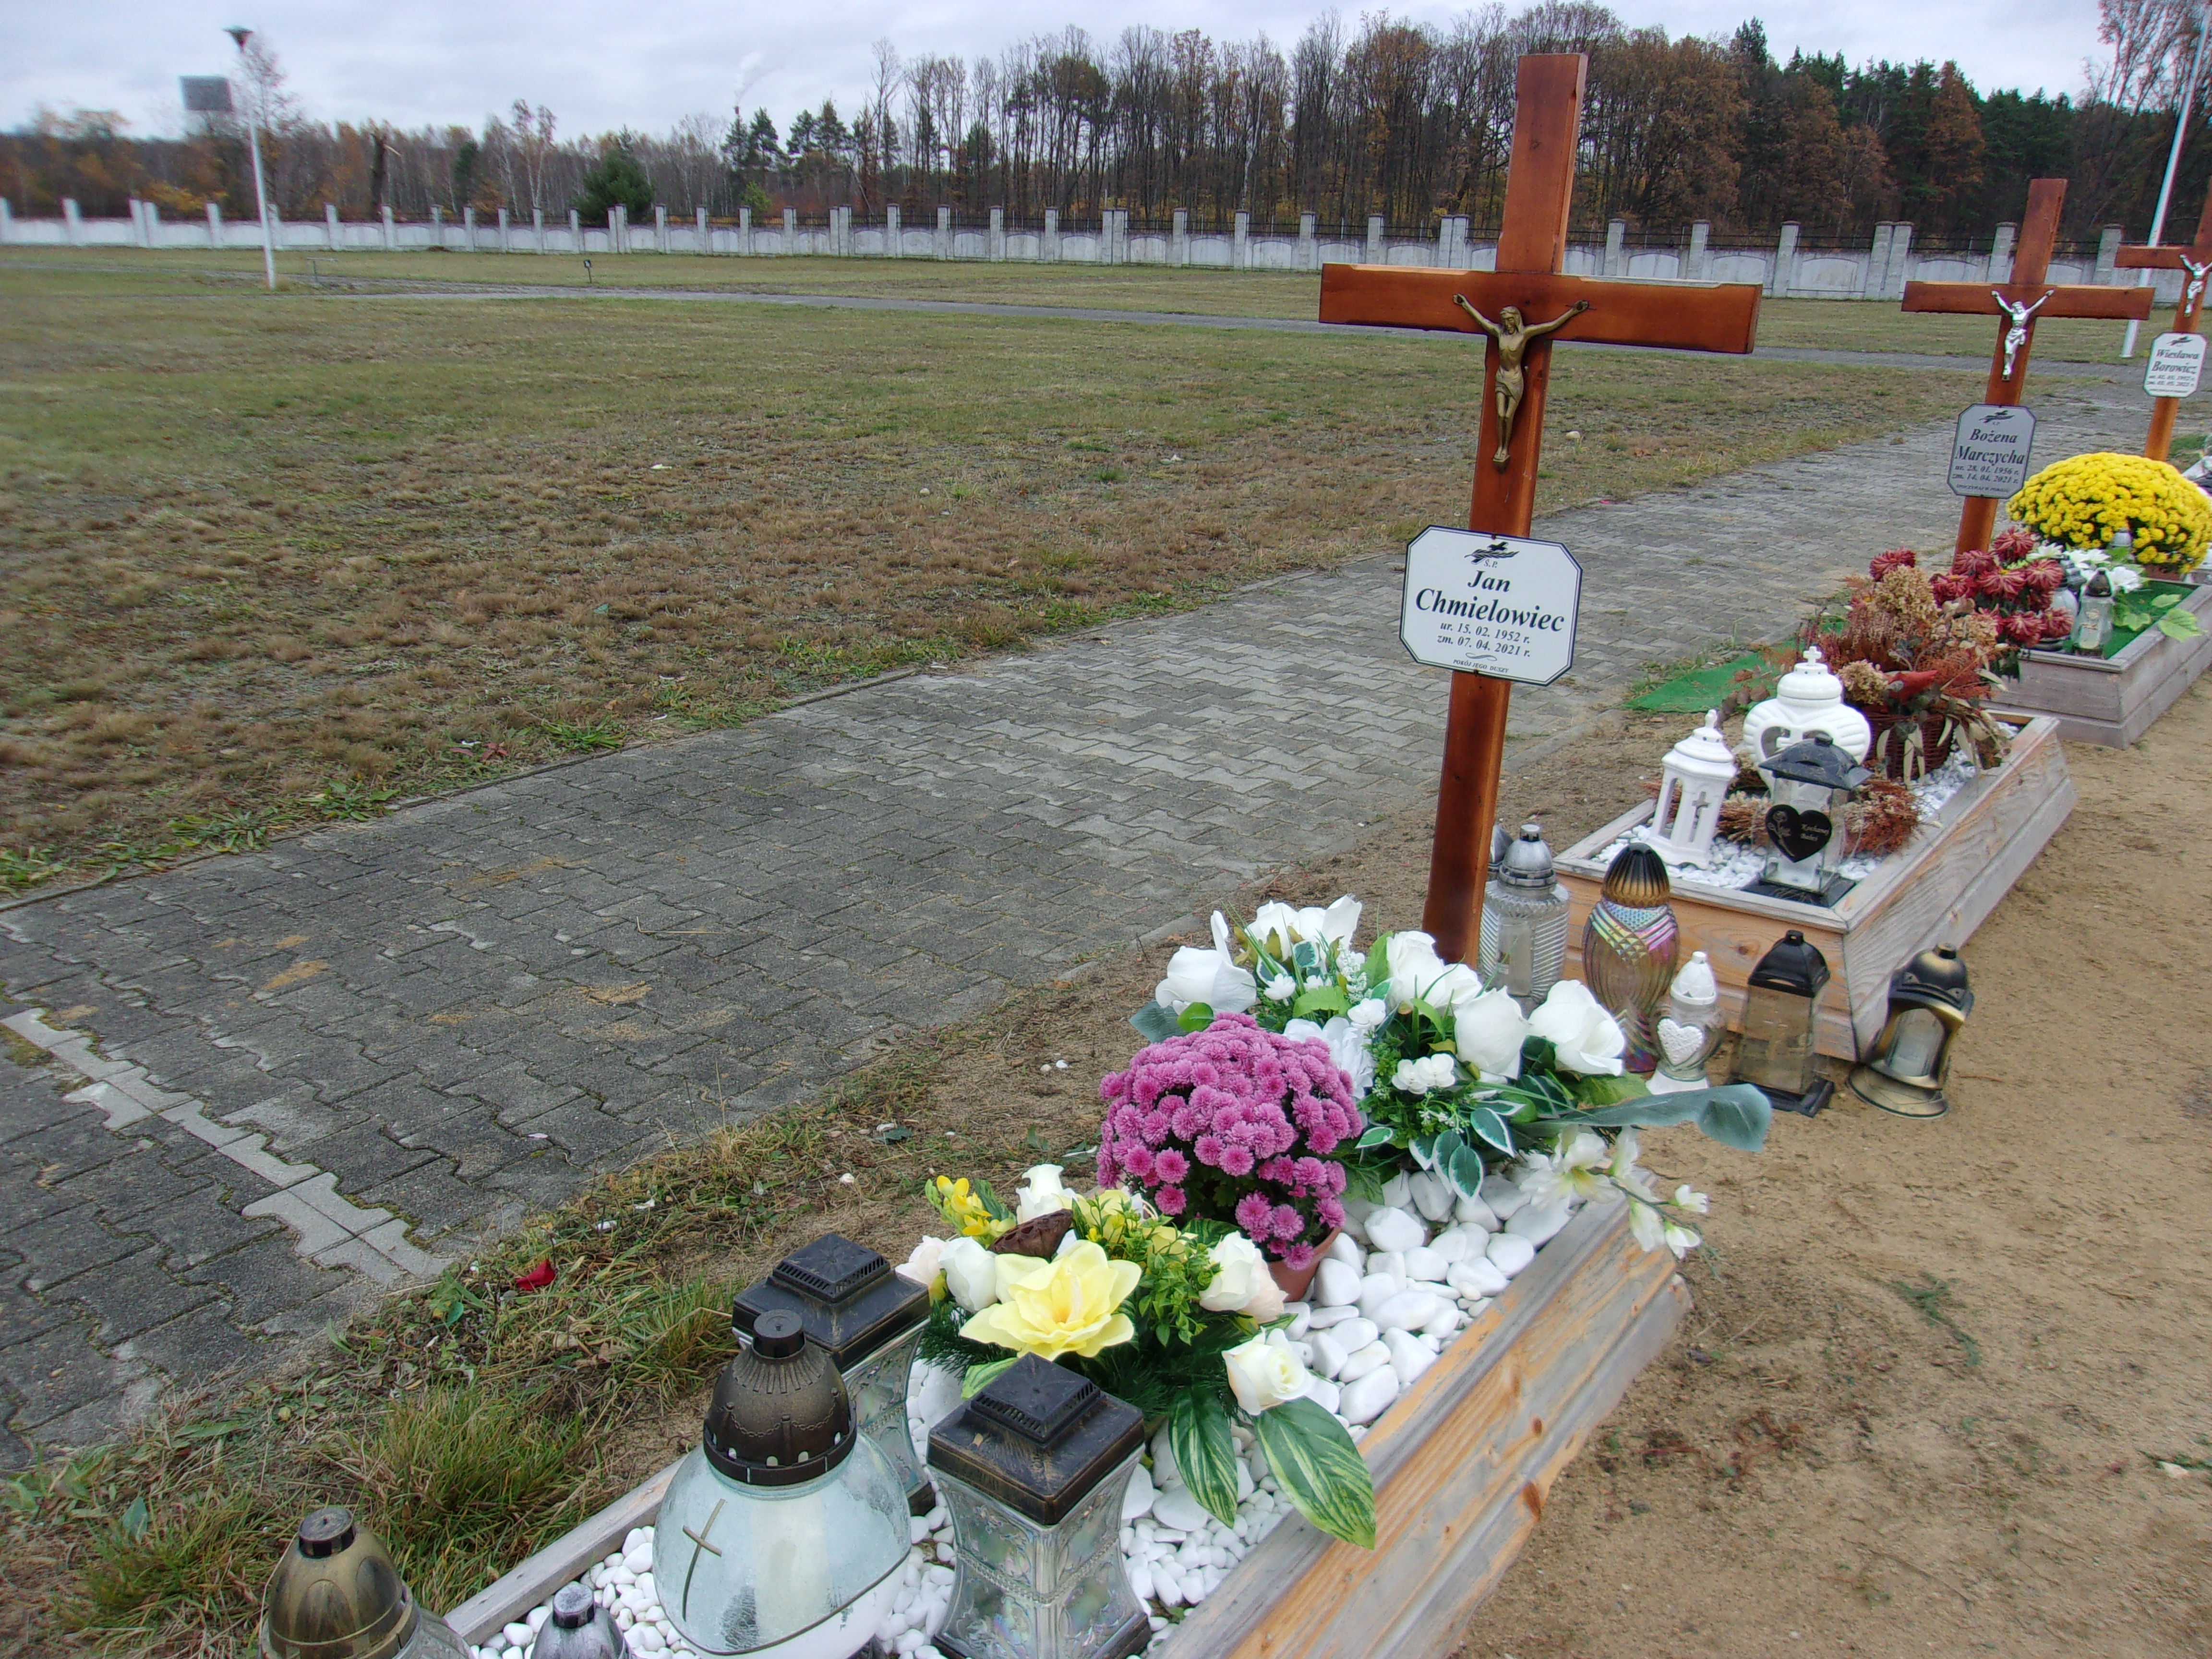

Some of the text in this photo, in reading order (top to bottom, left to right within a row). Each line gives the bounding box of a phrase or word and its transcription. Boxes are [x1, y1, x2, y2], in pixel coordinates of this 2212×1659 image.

[1969, 428, 2018, 443] Bożena
[1954, 445, 2025, 466] Marczycha
[1467, 570, 1511, 592] Jan
[1416, 588, 1565, 632] Chmielowiec
[1440, 623, 1530, 644] ur. 15. 02. 1952 r.
[1437, 635, 1454, 645] zm.
[1457, 637, 1472, 648] 07.
[1476, 639, 1491, 651] 04.
[1495, 642, 1521, 656] 2021
